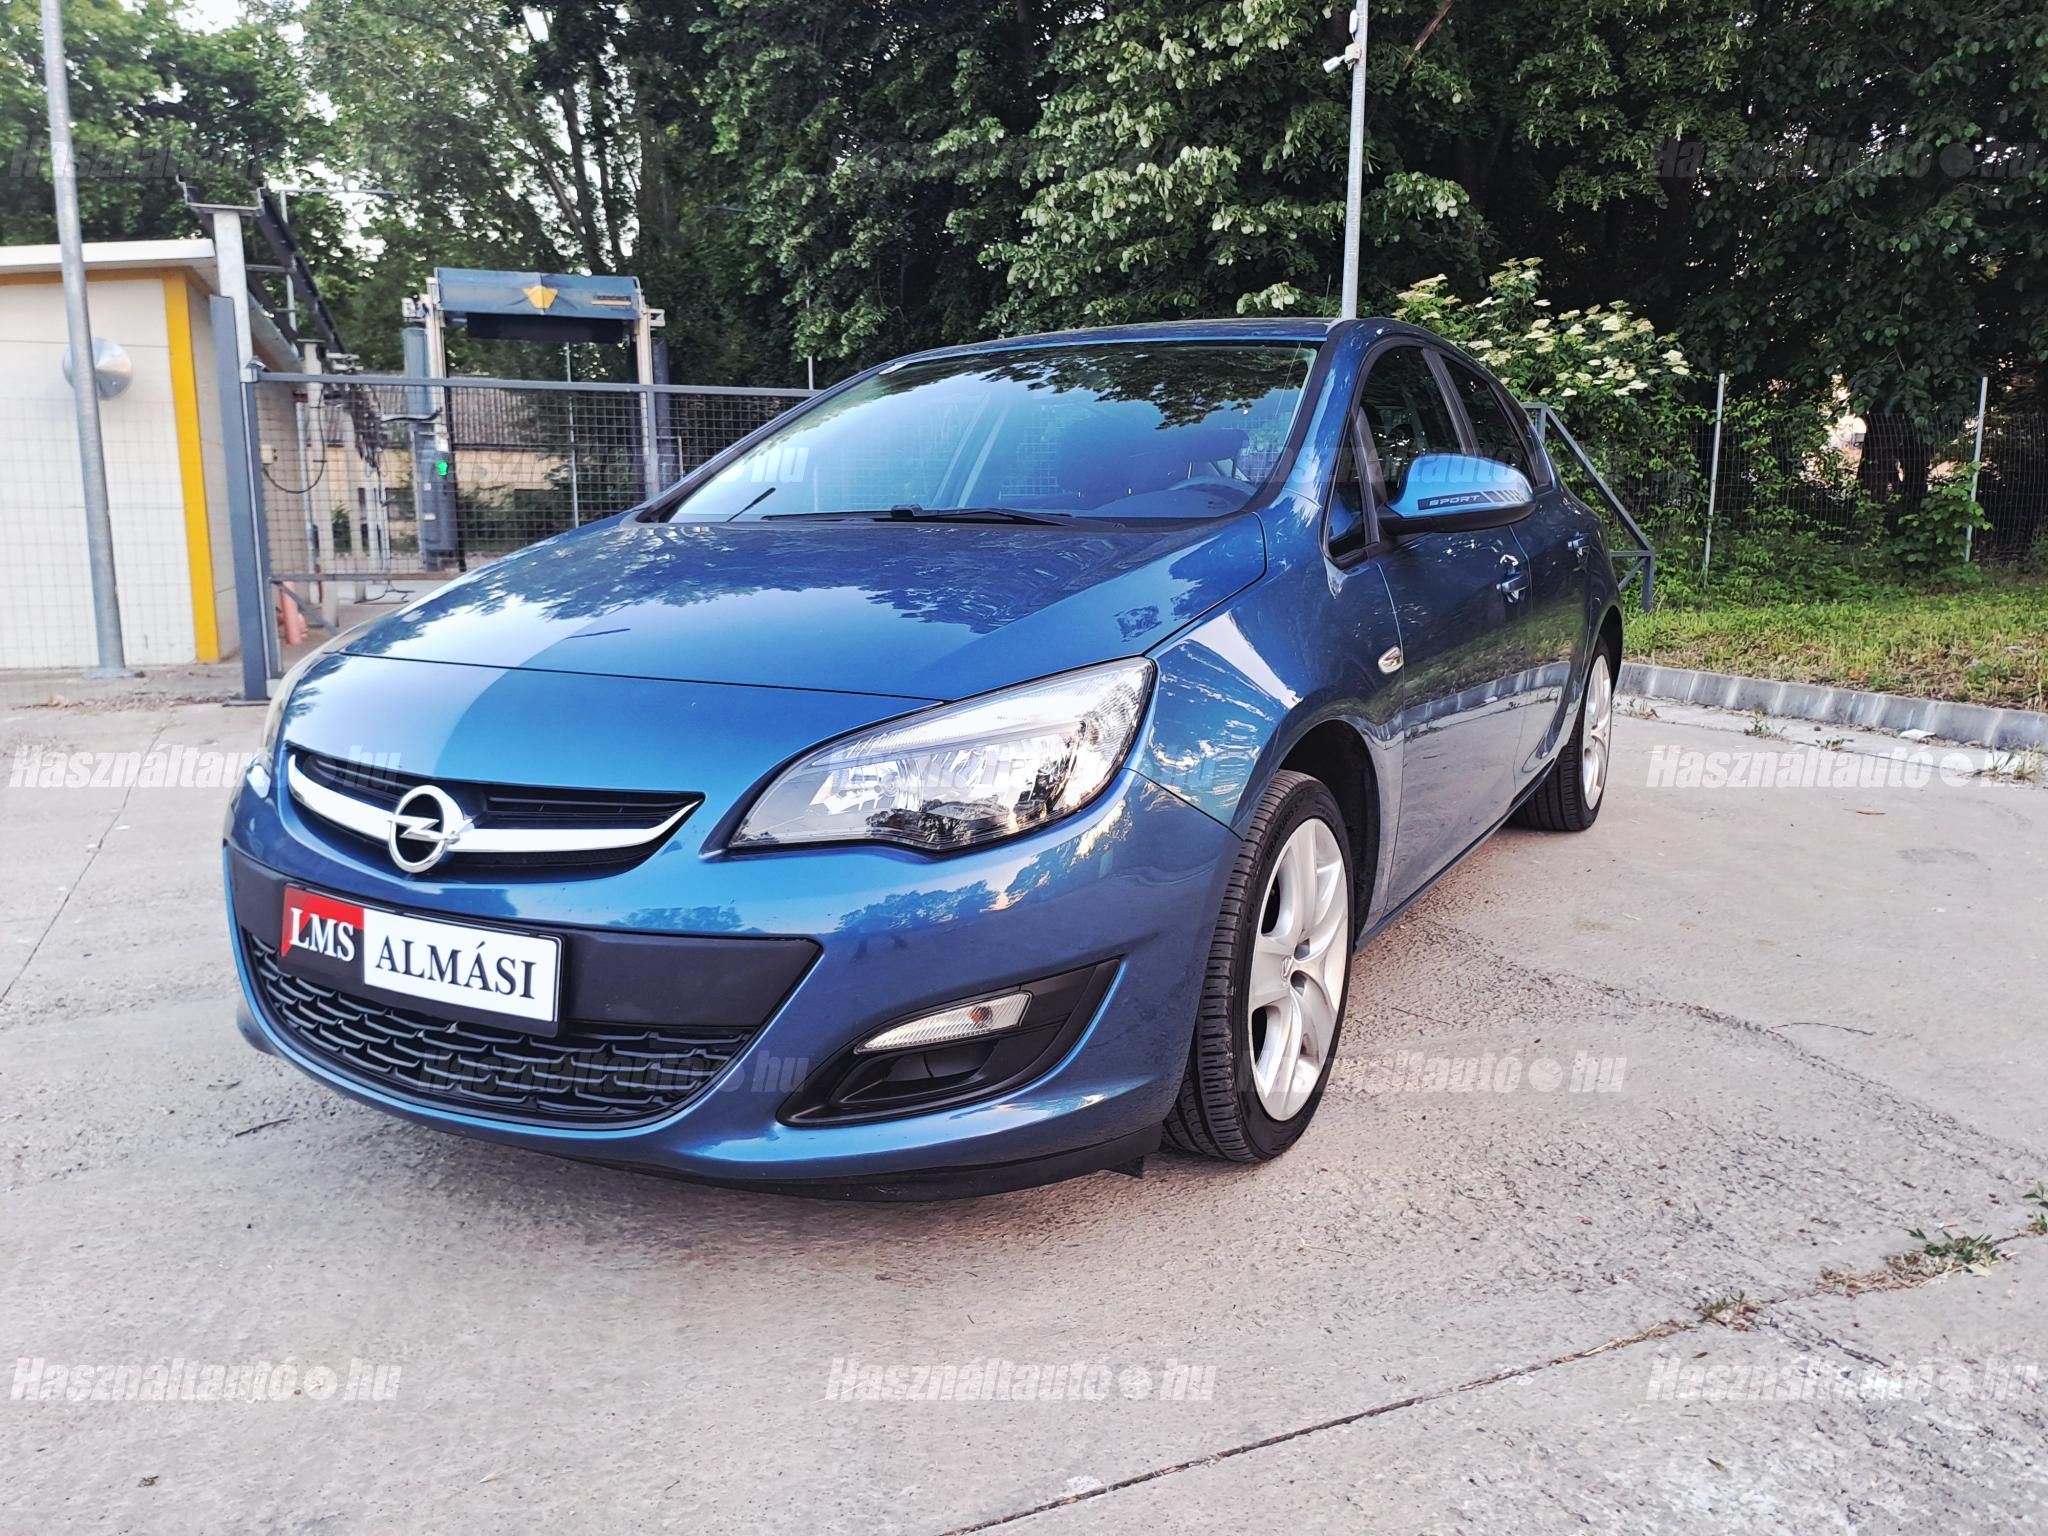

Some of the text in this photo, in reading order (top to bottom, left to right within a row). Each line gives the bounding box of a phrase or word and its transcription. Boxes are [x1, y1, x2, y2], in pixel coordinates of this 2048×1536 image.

[1429, 495, 1480, 506] SPORT
[289, 907, 537, 999] LMS ALMÁSI
